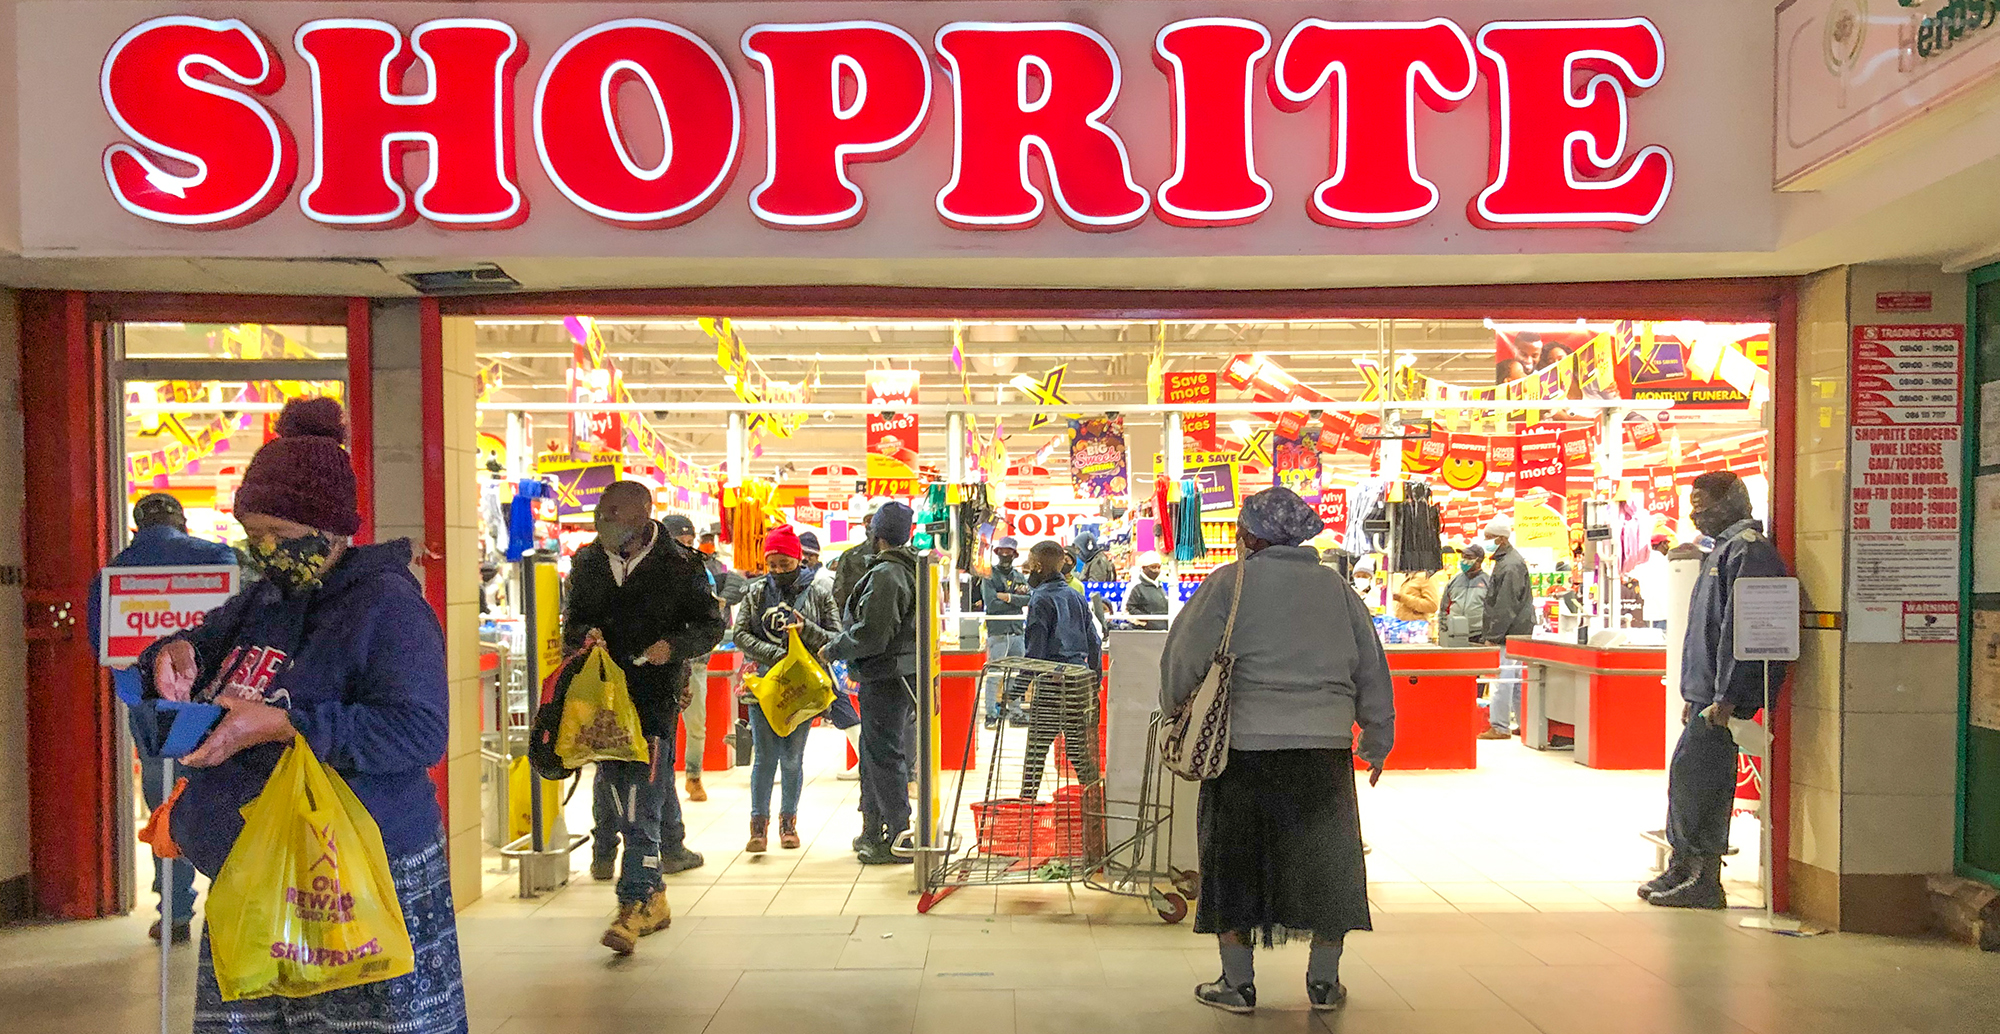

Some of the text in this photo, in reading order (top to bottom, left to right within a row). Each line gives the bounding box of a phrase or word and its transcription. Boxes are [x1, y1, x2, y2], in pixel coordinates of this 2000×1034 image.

[101, 16, 1674, 230] SHOPRITE
[1882, 328, 1920, 338] TRADING
[1922, 328, 1955, 338] HOURS
[1171, 374, 1208, 389] Save
[1170, 386, 1211, 401] more
[1635, 389, 1689, 401] MONTHLY
[1692, 389, 1744, 401] FUNERAL
[871, 416, 915, 433] more?
[1183, 420, 1210, 433] ices
[1855, 428, 1958, 441] SHOPRITE GROCERS
[1087, 444, 1107, 456] BIG
[1452, 443, 1486, 452] SHOPRITE
[1522, 443, 1556, 451] SHOPRITE
[1870, 443, 1942, 455] WINE LICENSE
[593, 454, 621, 463] SAVE
[1075, 446, 1121, 468] Sweets
[1208, 454, 1236, 463] SAVE
[1276, 450, 1318, 471] BIG
[1278, 468, 1318, 485] TOY
[1520, 462, 1563, 480] more?
[1863, 472, 1948, 485] TRADING HOURS
[869, 480, 899, 495] 179
[1853, 487, 1889, 500] MON-FRI
[1321, 492, 1343, 504] Why
[1319, 504, 1343, 516] Pay
[1648, 498, 1675, 512] day!
[1853, 502, 1869, 515] SAT
[1853, 517, 1870, 529] SUN
[1905, 603, 1957, 612] WARNING
[126, 610, 205, 636] queue
[270, 937, 383, 967] SHOPRITE
